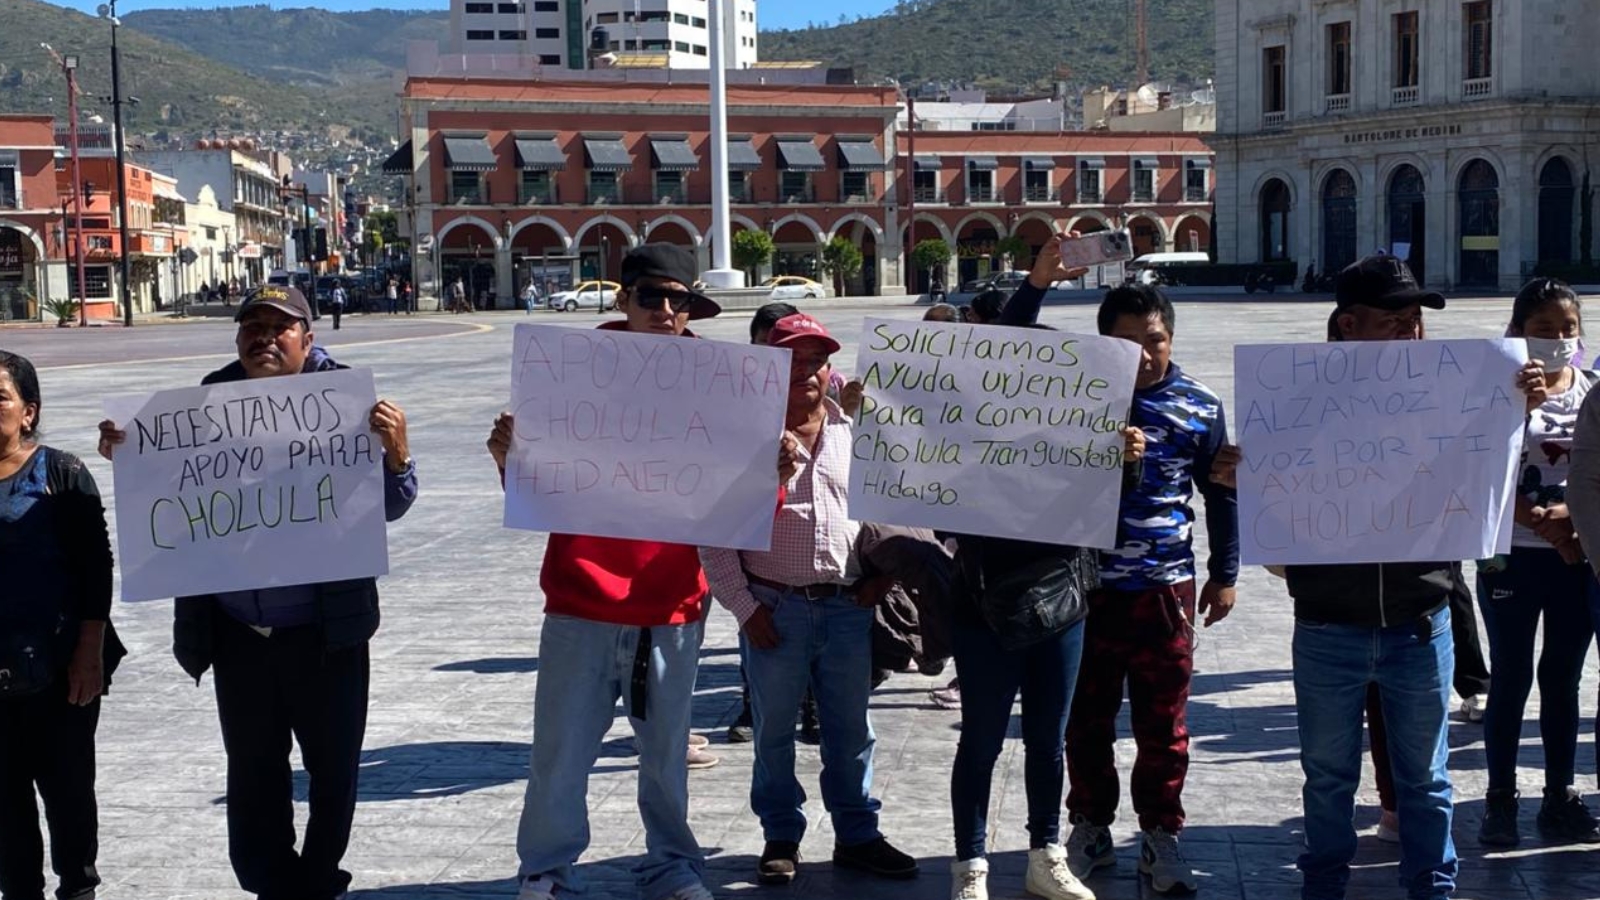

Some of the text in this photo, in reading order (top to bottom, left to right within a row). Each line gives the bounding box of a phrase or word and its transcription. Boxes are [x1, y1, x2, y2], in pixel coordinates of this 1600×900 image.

[1405, 128, 1419, 139] DE
[1421, 124, 1462, 137] MEDINA
[869, 323, 1079, 367] Solicitamos
[1256, 344, 1464, 391] CHOLULA
[133, 388, 341, 454] NECESITAMOS
[512, 397, 713, 445] CHOLULA
[938, 401, 963, 424] la
[1242, 384, 1512, 435] ALZAMOZ LA
[178, 433, 374, 492] APOYO PARA
[853, 429, 963, 465] Cholula
[1244, 434, 1491, 474] VOZ POR TI
[513, 459, 704, 497] HIDALGO
[1261, 461, 1434, 498] AYUDA A
[150, 473, 339, 549] CHOLULA
[1252, 490, 1473, 551] CHOLULA
